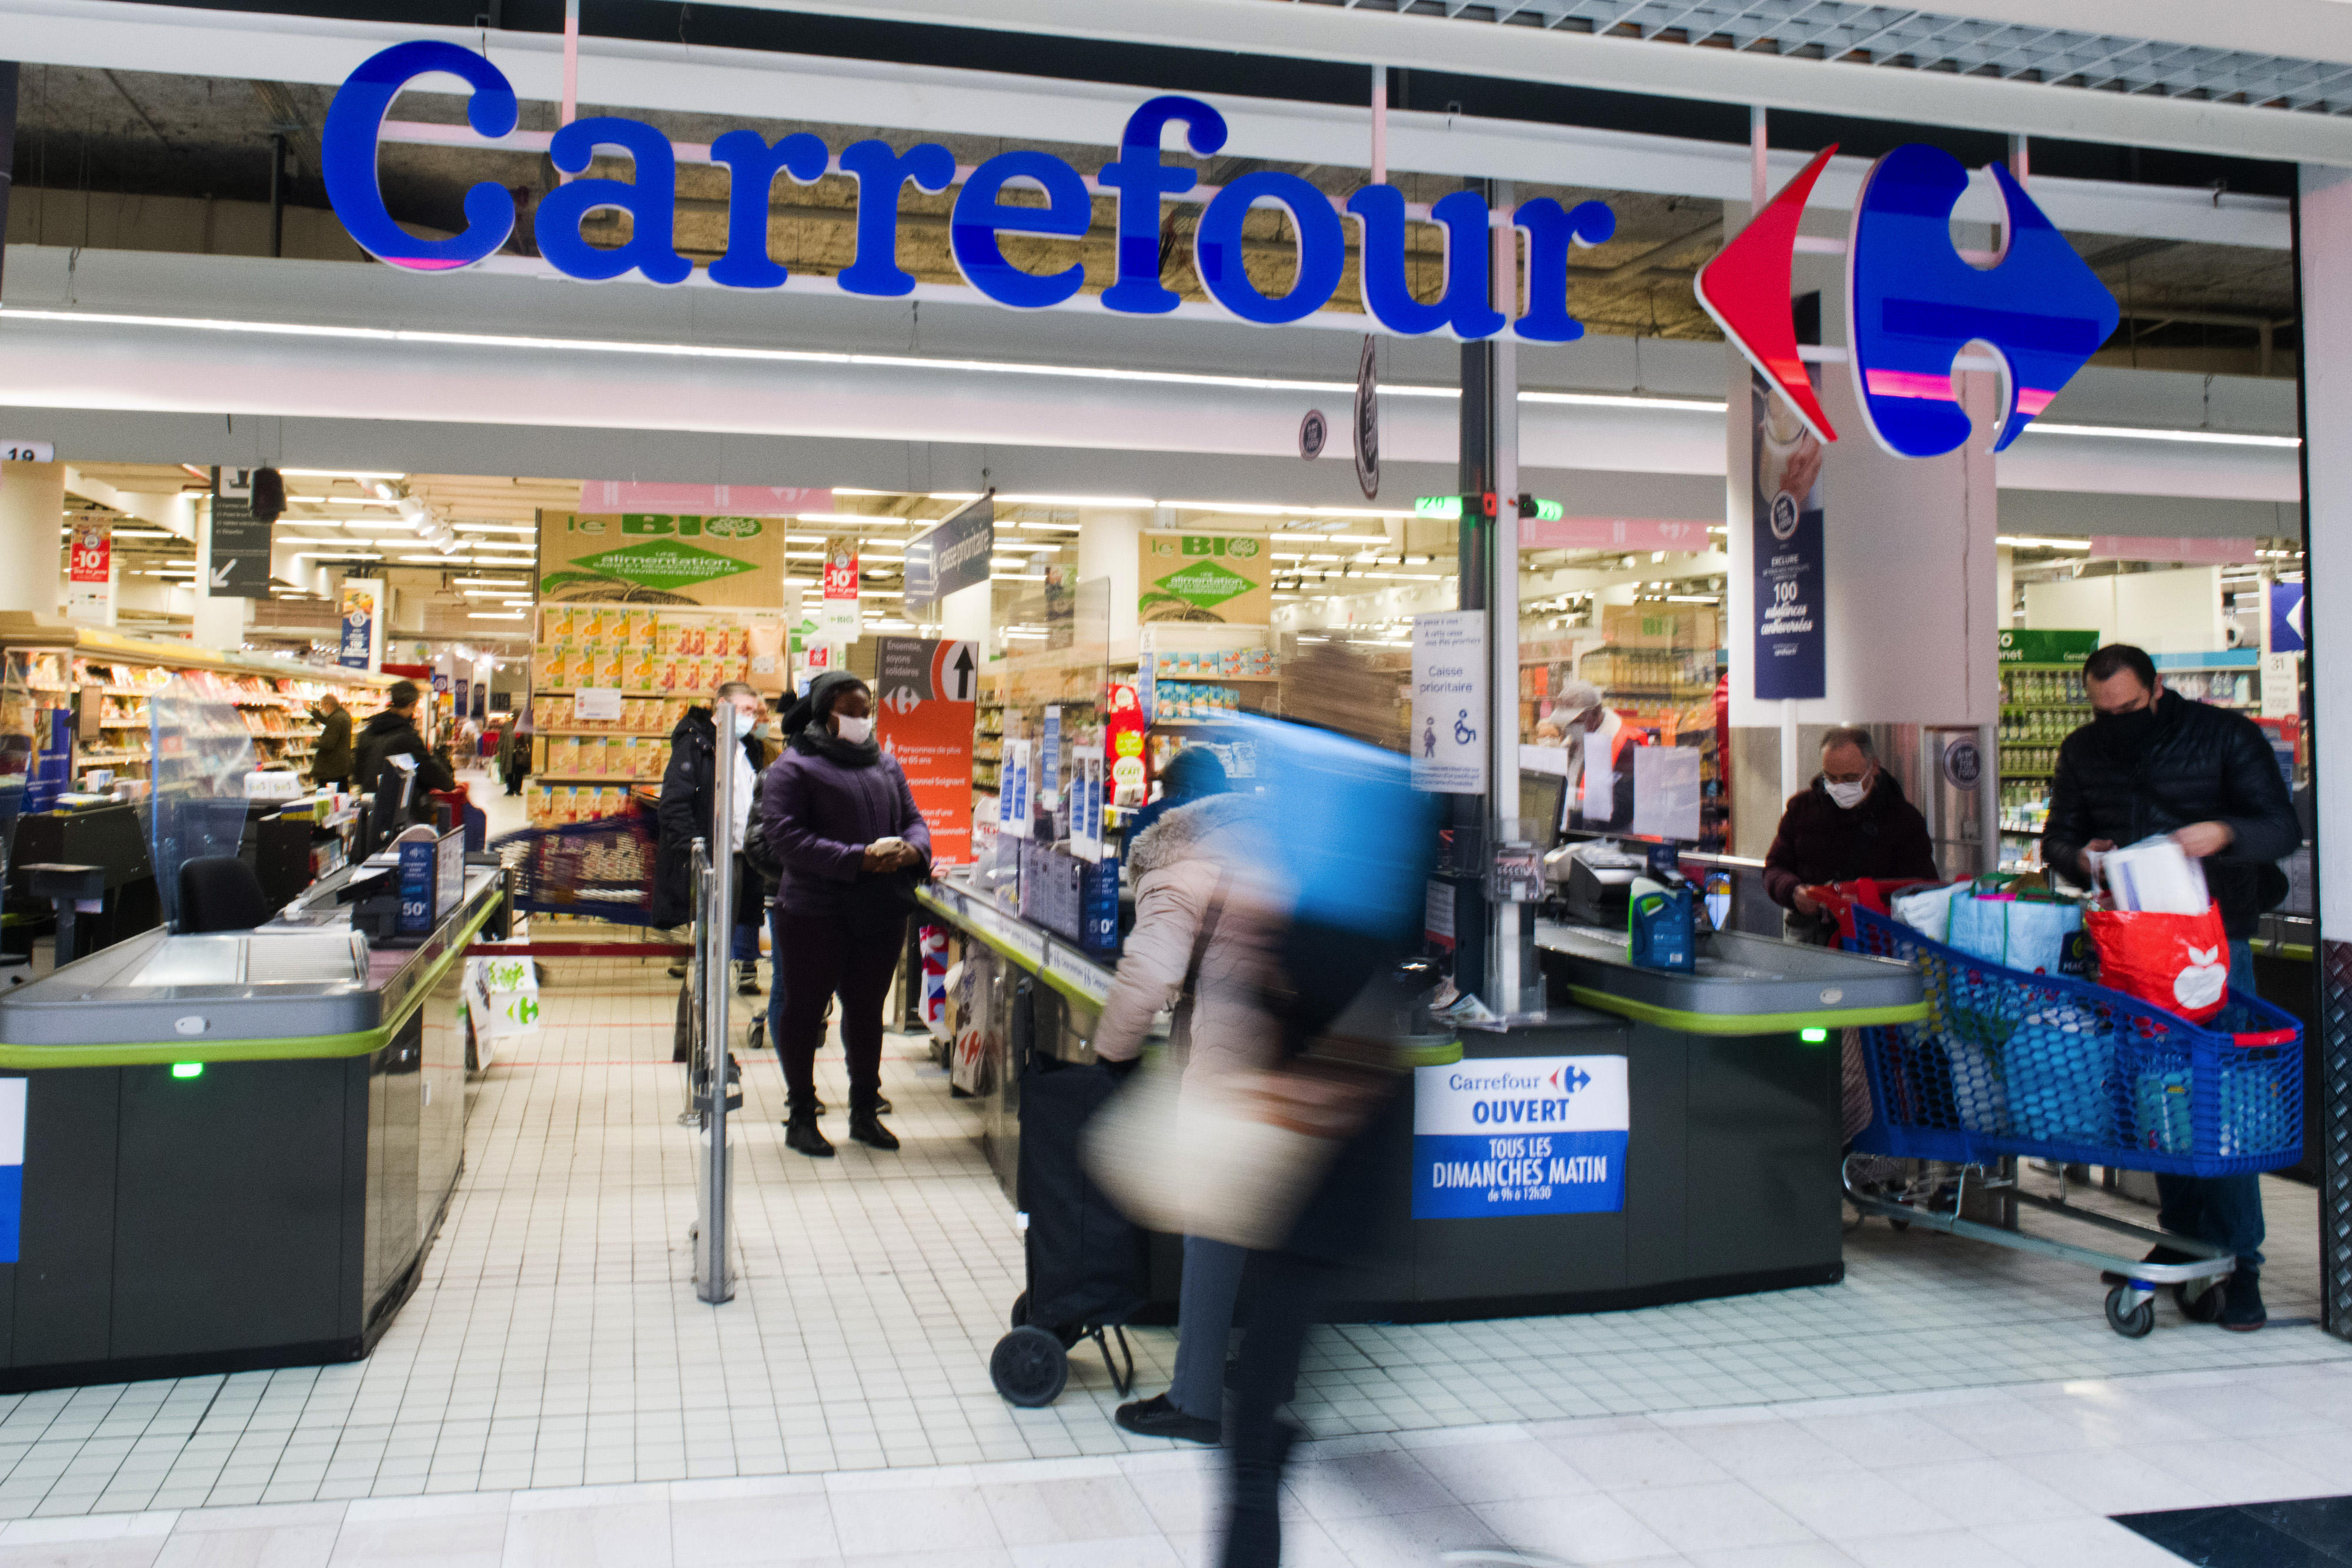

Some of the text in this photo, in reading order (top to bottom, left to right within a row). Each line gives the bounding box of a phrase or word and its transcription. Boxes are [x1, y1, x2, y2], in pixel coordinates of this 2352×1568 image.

[322, 39, 1616, 343] Carrefour
[8, 447, 35, 462] 19
[621, 513, 763, 541] BIO
[957, 522, 989, 573] prioritaire
[1181, 536, 1259, 560] BIO
[601, 554, 731, 566] alimentation
[1171, 576, 1243, 586] alimentation
[1774, 580, 1798, 602] 100
[887, 640, 922, 653] Ensemble,
[886, 655, 911, 666] soyons
[2271, 656, 2284, 671] 31
[885, 667, 919, 677] solidaires
[1428, 666, 1463, 677] Caisse
[1419, 682, 1472, 696] prioritaire
[898, 745, 962, 755] Personnes de plus
[897, 755, 907, 764] de
[908, 755, 918, 764] 65
[907, 777, 934, 786] rsonnel
[1449, 1072, 1541, 1091] Carrefour
[1472, 1098, 1570, 1124] OUVERT
[1489, 1136, 1552, 1159] TOUS LES
[1432, 1155, 1608, 1188] DIMANCHES MATIN
[1488, 1189, 1499, 1202] de
[1501, 1188, 1513, 1202] 9h
[1523, 1185, 1552, 1201] 12h30
